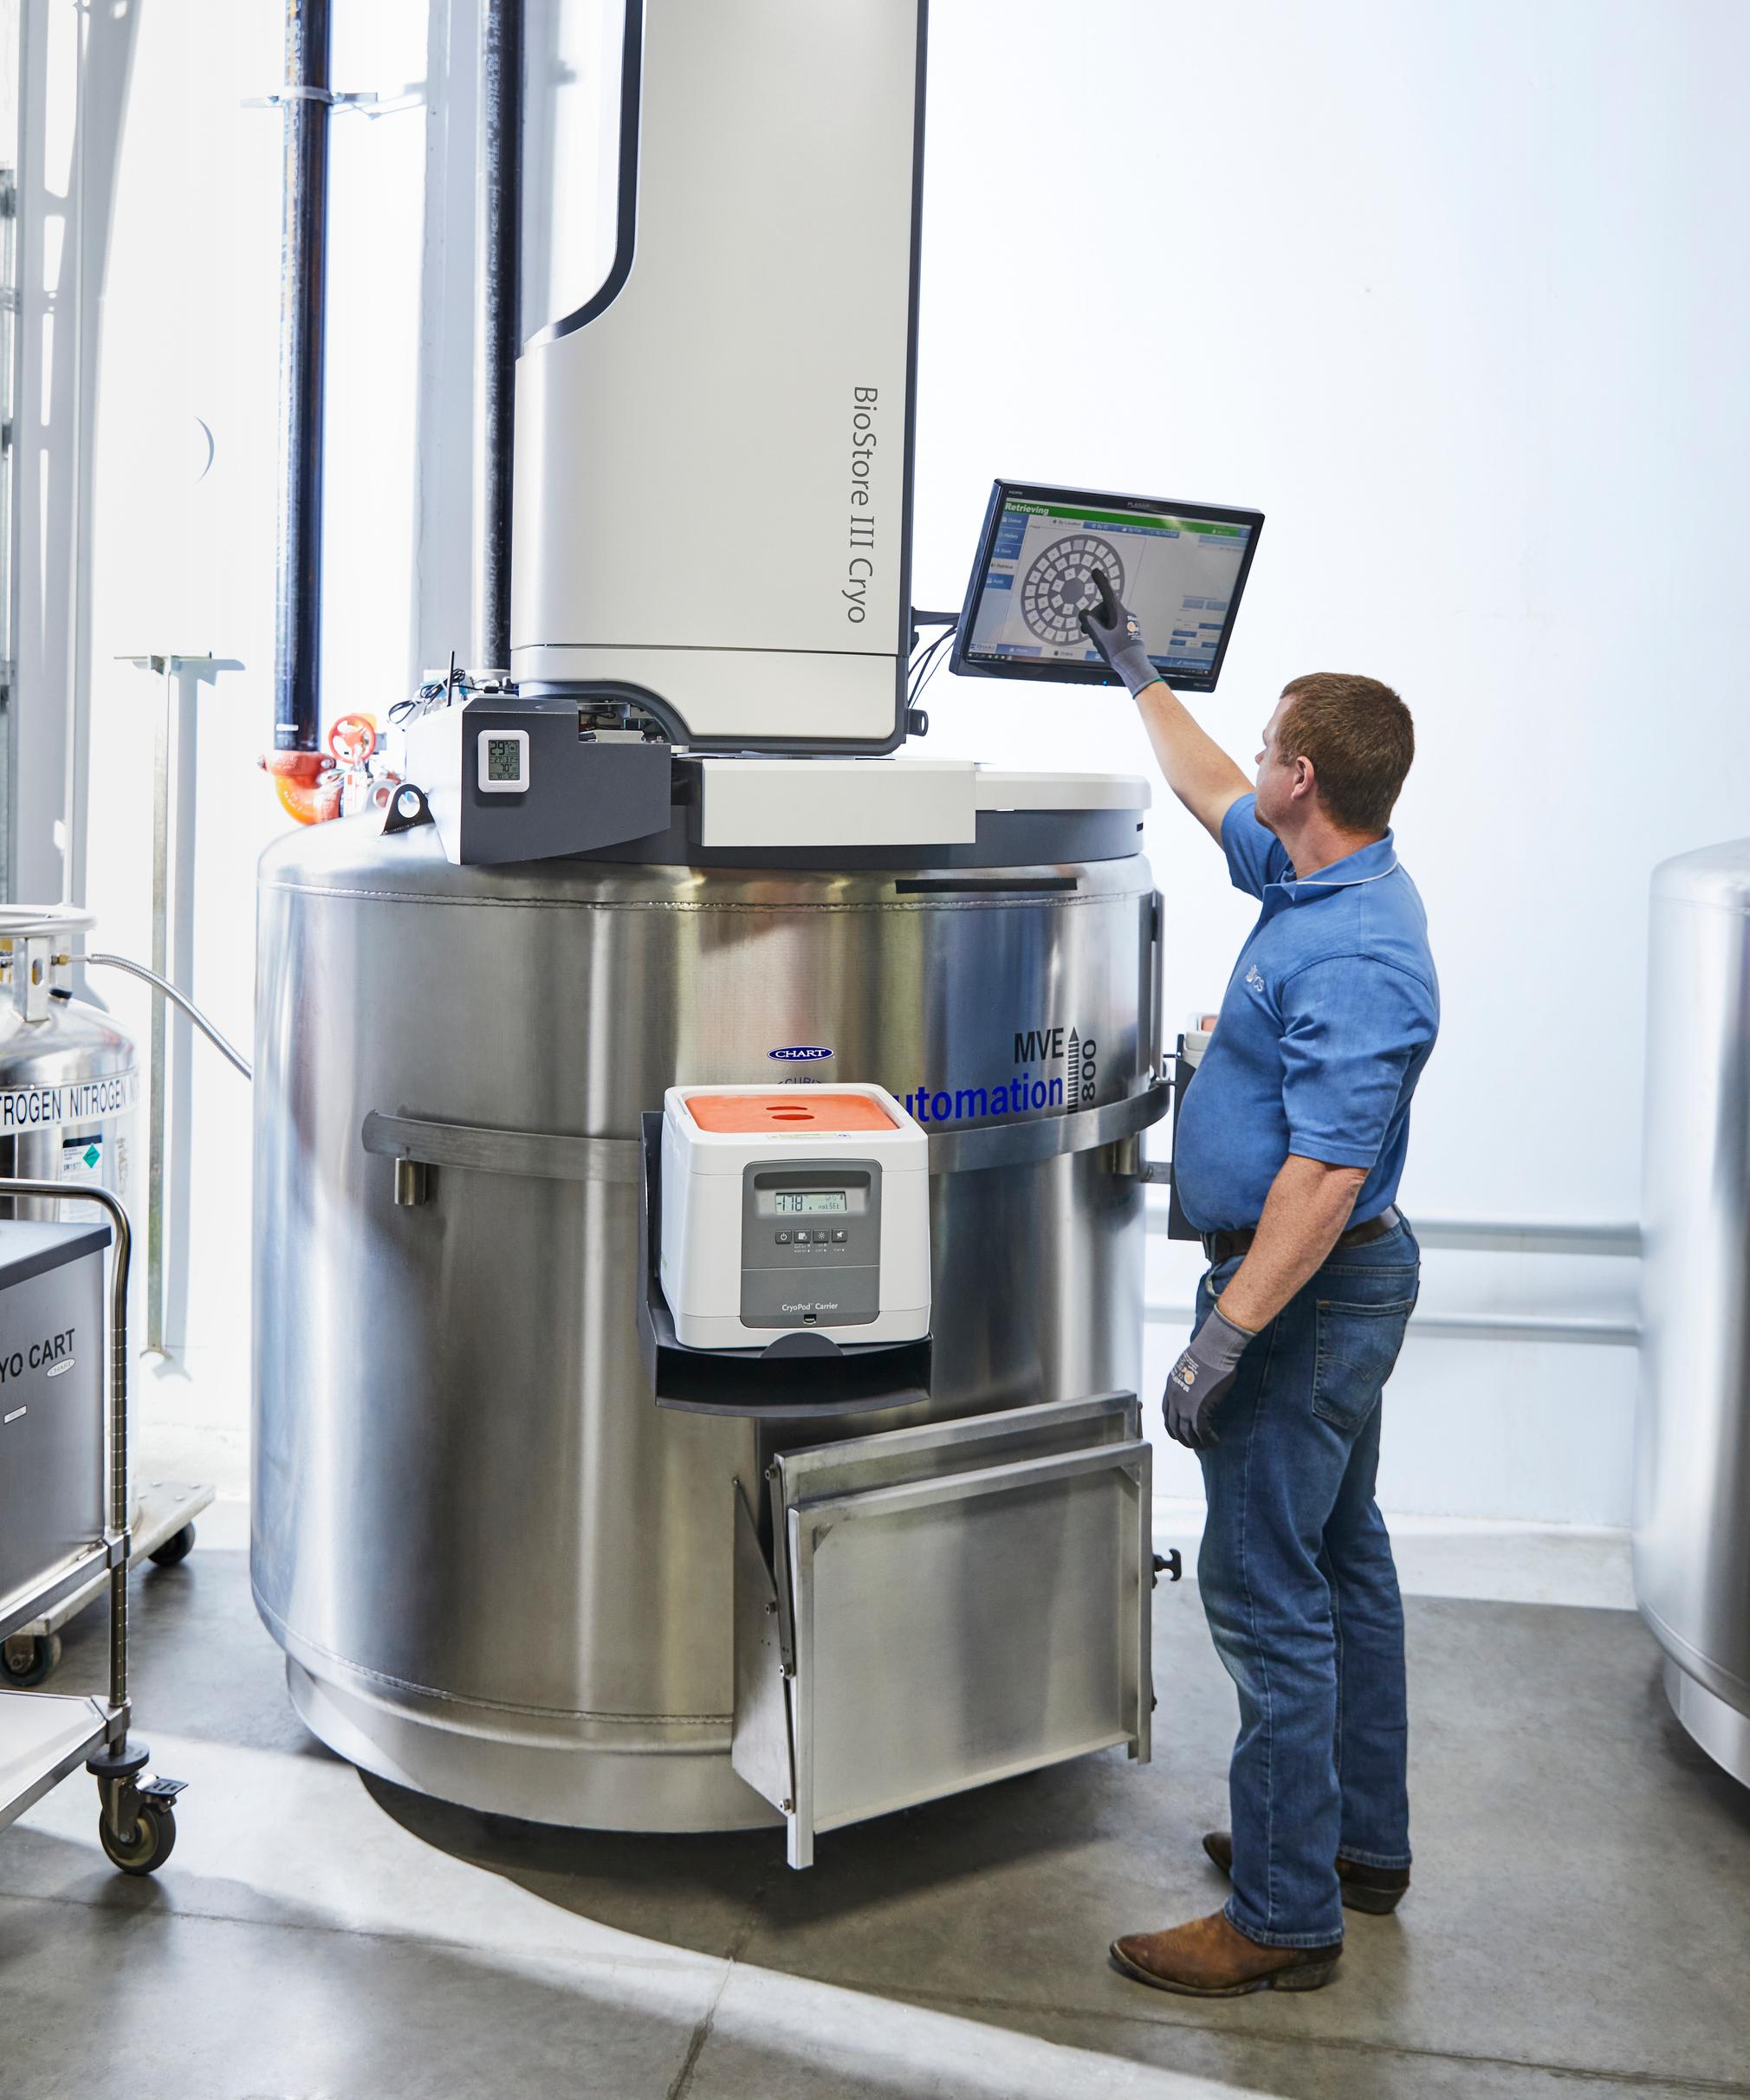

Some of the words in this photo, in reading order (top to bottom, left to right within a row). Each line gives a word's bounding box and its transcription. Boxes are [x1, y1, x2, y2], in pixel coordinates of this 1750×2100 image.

[851, 386, 878, 506] BioStore
[1005, 502, 1049, 516] Retrieving
[850, 515, 874, 548] III
[841, 558, 873, 624] Cryo
[775, 1049, 826, 1058] CHART
[1014, 1027, 1065, 1064] MVE
[1081, 1039, 1097, 1108] 800
[70, 1079, 126, 1118] NITROGEN
[29, 1328, 75, 1369] CART
